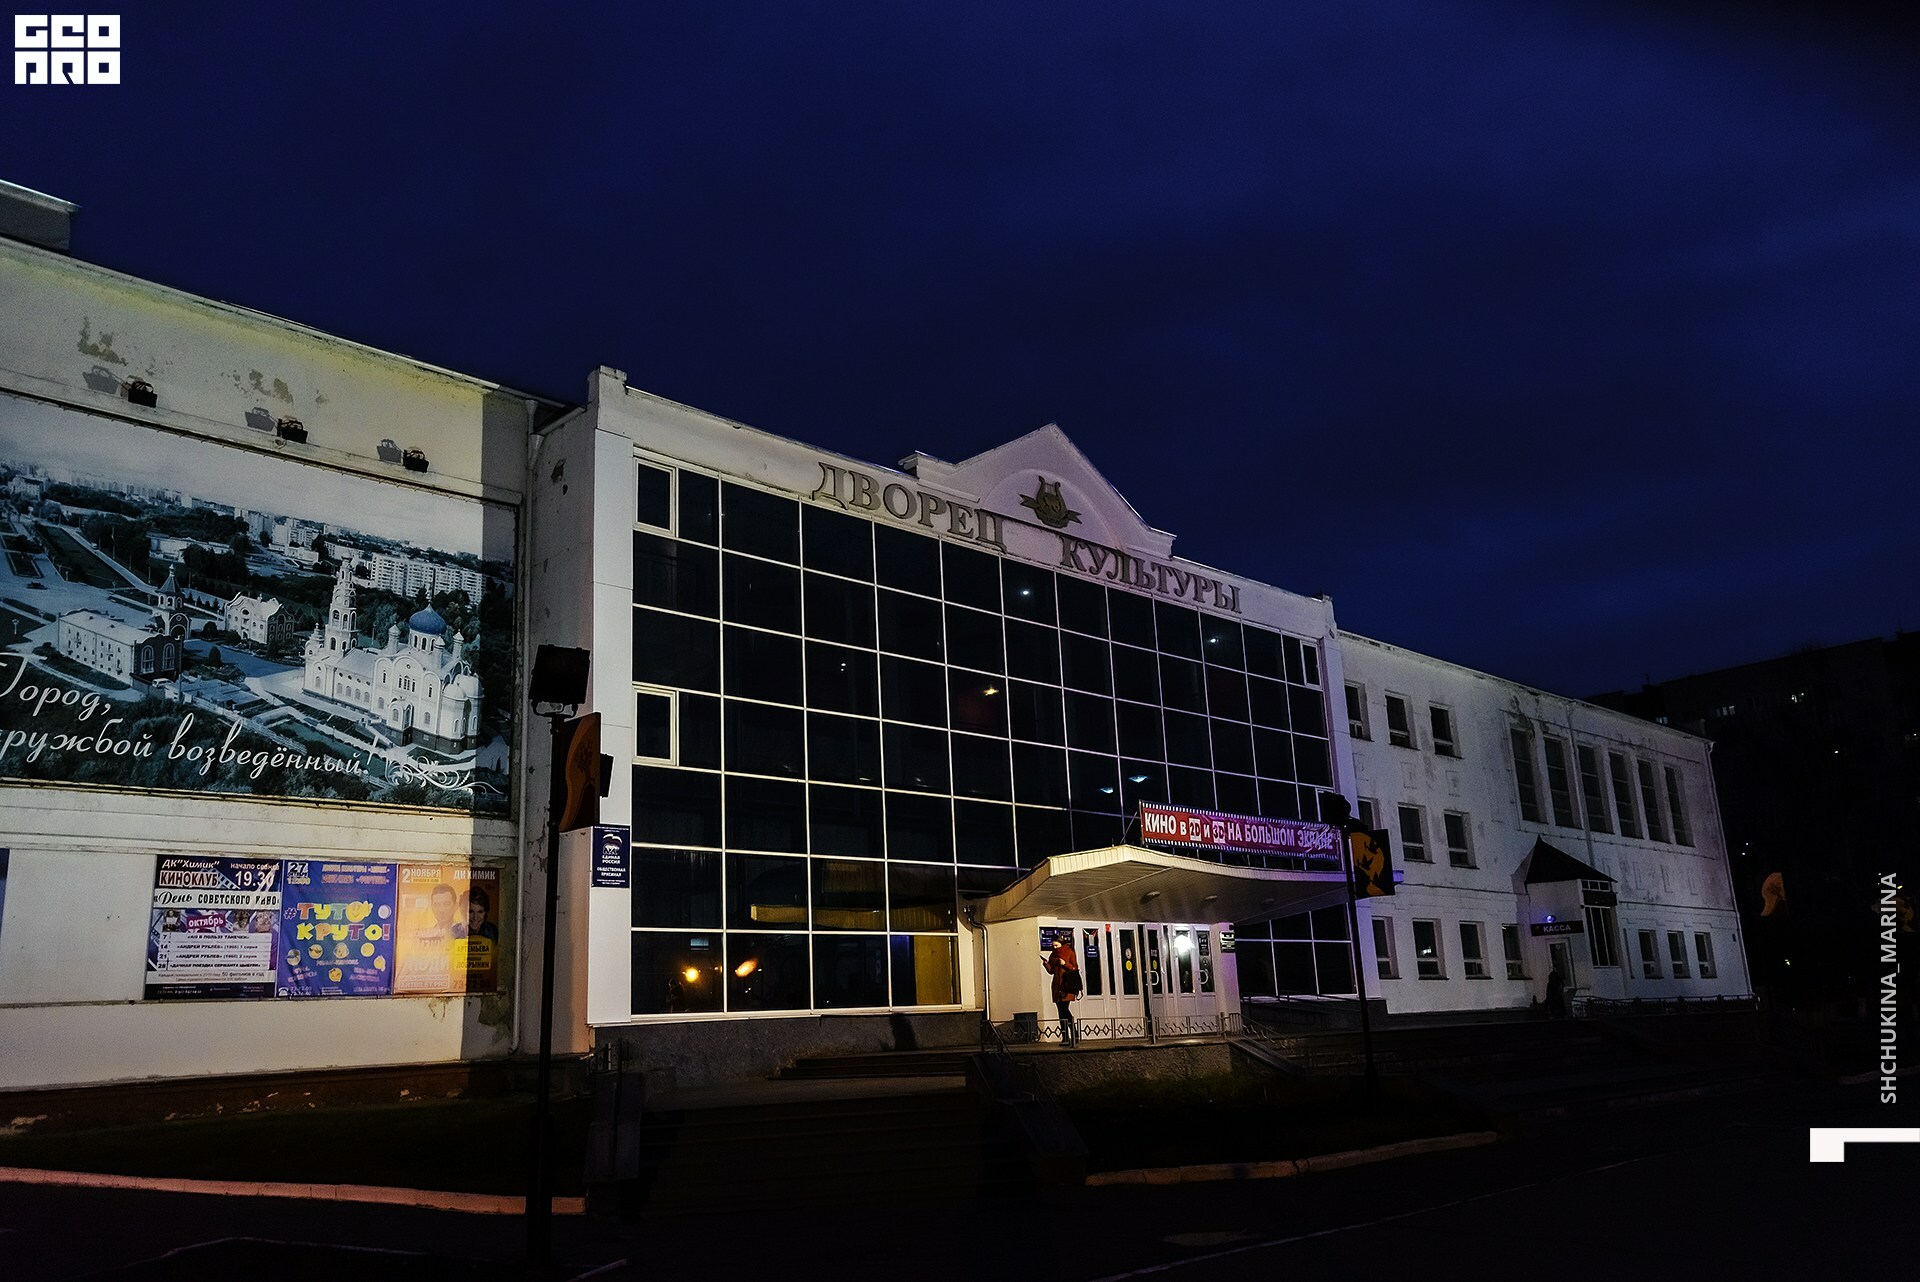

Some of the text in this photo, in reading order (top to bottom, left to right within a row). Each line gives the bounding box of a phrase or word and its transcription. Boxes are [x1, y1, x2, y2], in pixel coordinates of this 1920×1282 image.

[810, 462, 1008, 555] ДВОРЕЦ
[1060, 535, 1242, 615] КУЛЬТУРЫ
[0, 713, 378, 780] ружбой возведённый!
[1144, 812, 1177, 835] КИНО
[1190, 821, 1201, 837] 2D
[1213, 823, 1225, 839] 3D
[1227, 822, 1243, 842] НА
[1244, 823, 1295, 847] БОЛЬШОМ
[1297, 828, 1334, 850] ЭКРАНЕ
[230, 862, 256, 870] начало
[289, 862, 307, 874] 27
[160, 870, 219, 888] КИНОКЛУБ
[235, 870, 276, 888] 19.30
[402, 868, 411, 884] 2
[411, 868, 441, 878] НОЯБРЯ
[467, 870, 496, 880] ХИМИК
[198, 894, 251, 905] СОВЕТСКОГО
[188, 916, 224, 931] октябрь
[296, 922, 391, 941] КРУТО!
[1543, 924, 1572, 933] КАССА
